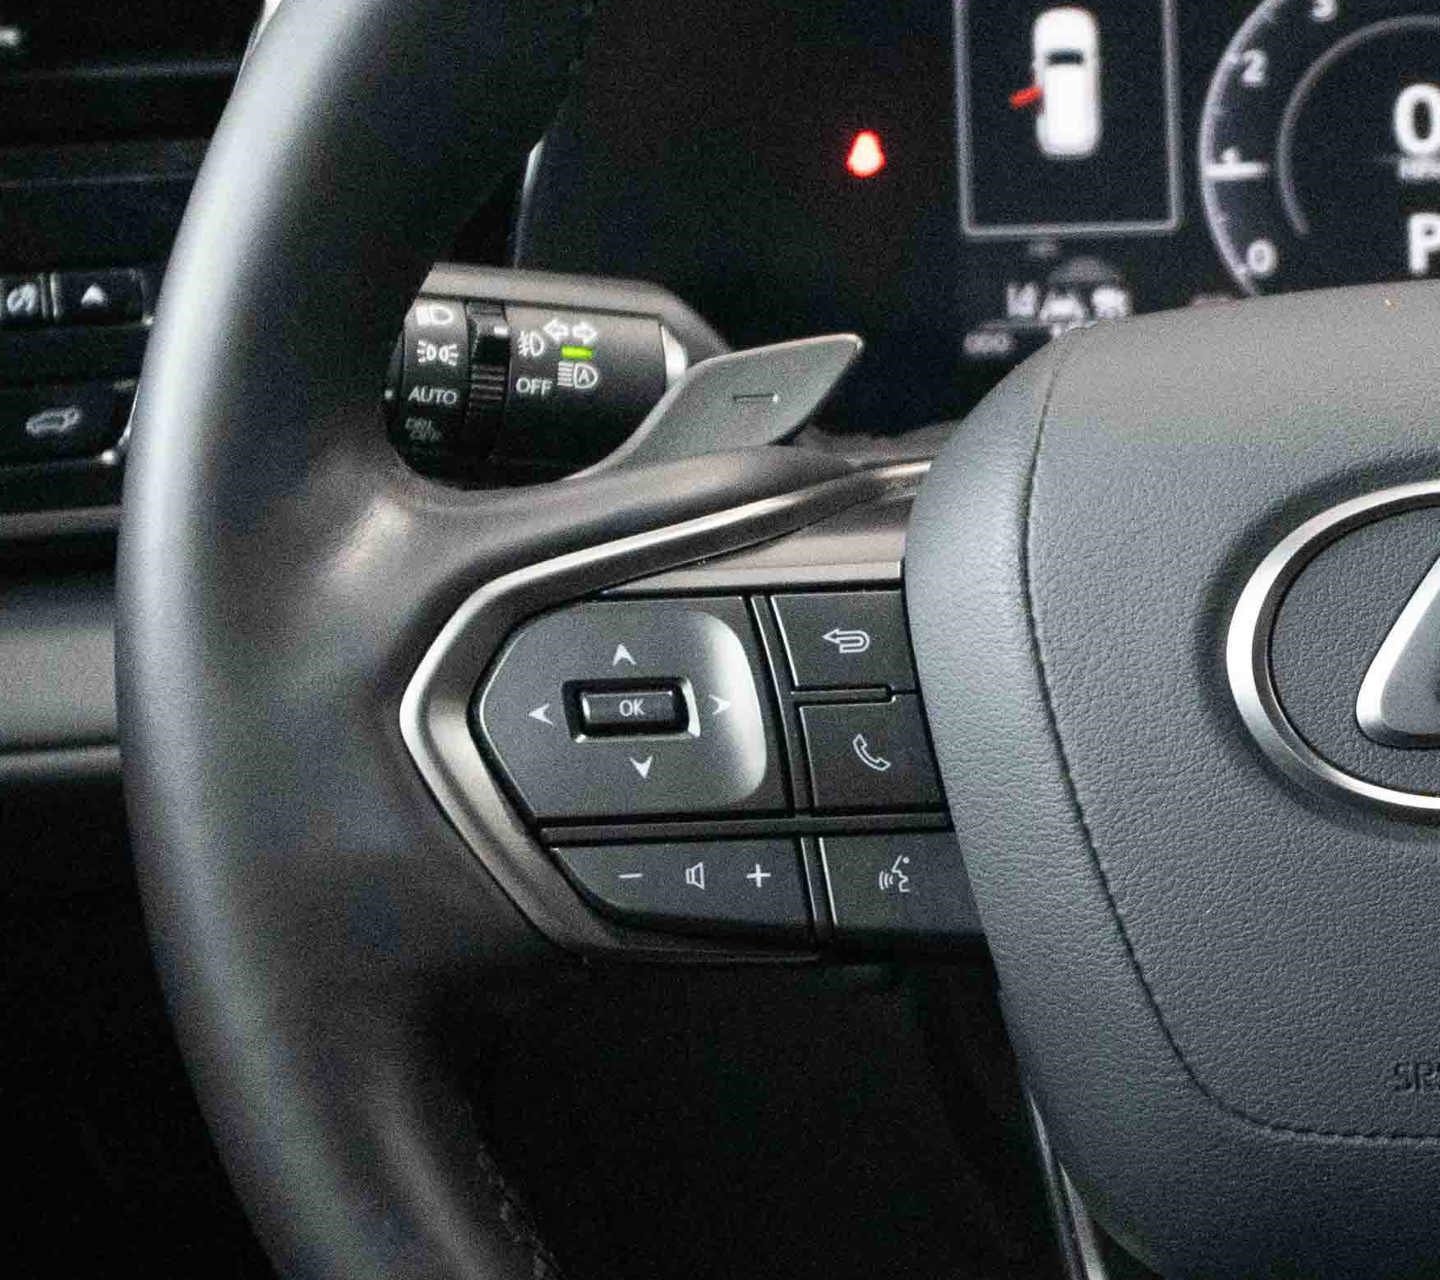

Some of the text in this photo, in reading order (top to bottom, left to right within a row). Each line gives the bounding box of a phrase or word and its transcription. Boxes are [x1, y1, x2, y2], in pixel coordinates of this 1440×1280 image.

[1240, 50, 1268, 86] 2
[1246, 239, 1277, 274] 0
[408, 386, 458, 406] AUTO
[516, 377, 553, 397] OFF
[619, 696, 646, 717] OK
